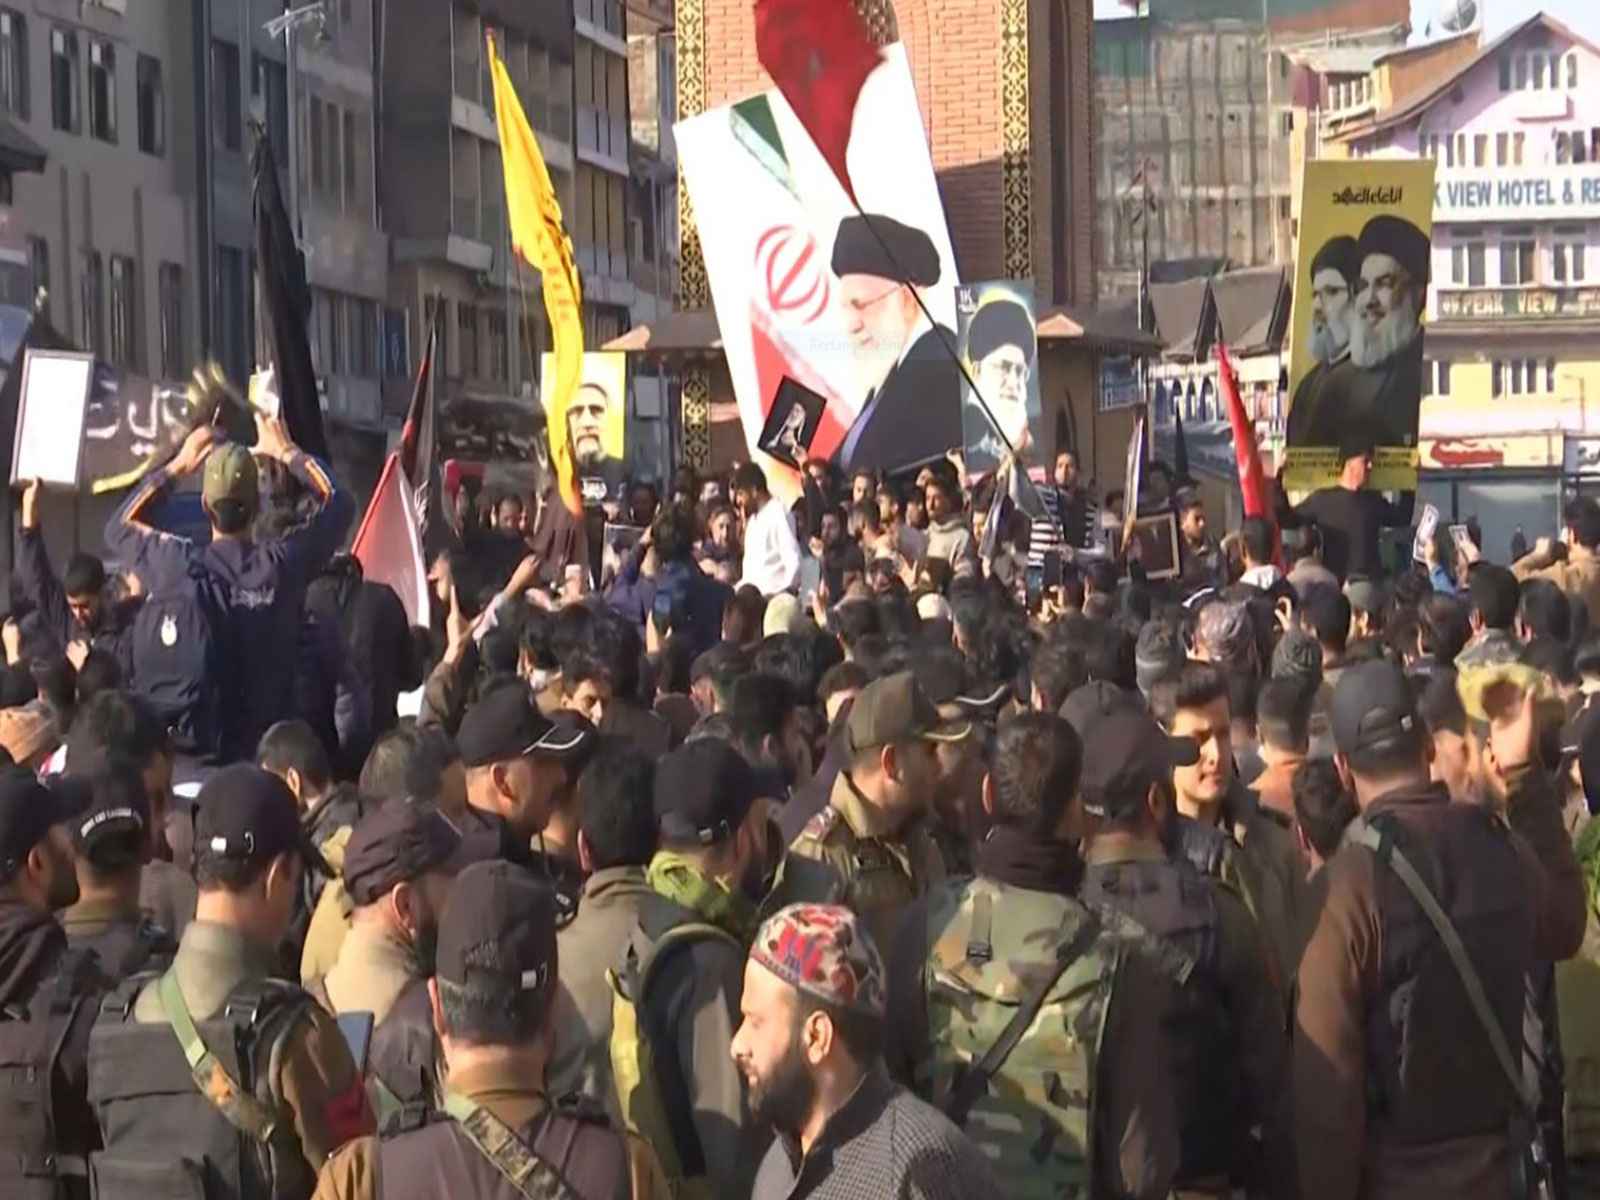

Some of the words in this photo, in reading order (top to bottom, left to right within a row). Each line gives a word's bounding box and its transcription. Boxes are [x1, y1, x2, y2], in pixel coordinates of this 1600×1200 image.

[1447, 181, 1491, 207] VIEW
[1498, 178, 1555, 207] HOTEL
[1562, 178, 1574, 205] &
[1518, 287, 1557, 314] VIEW
